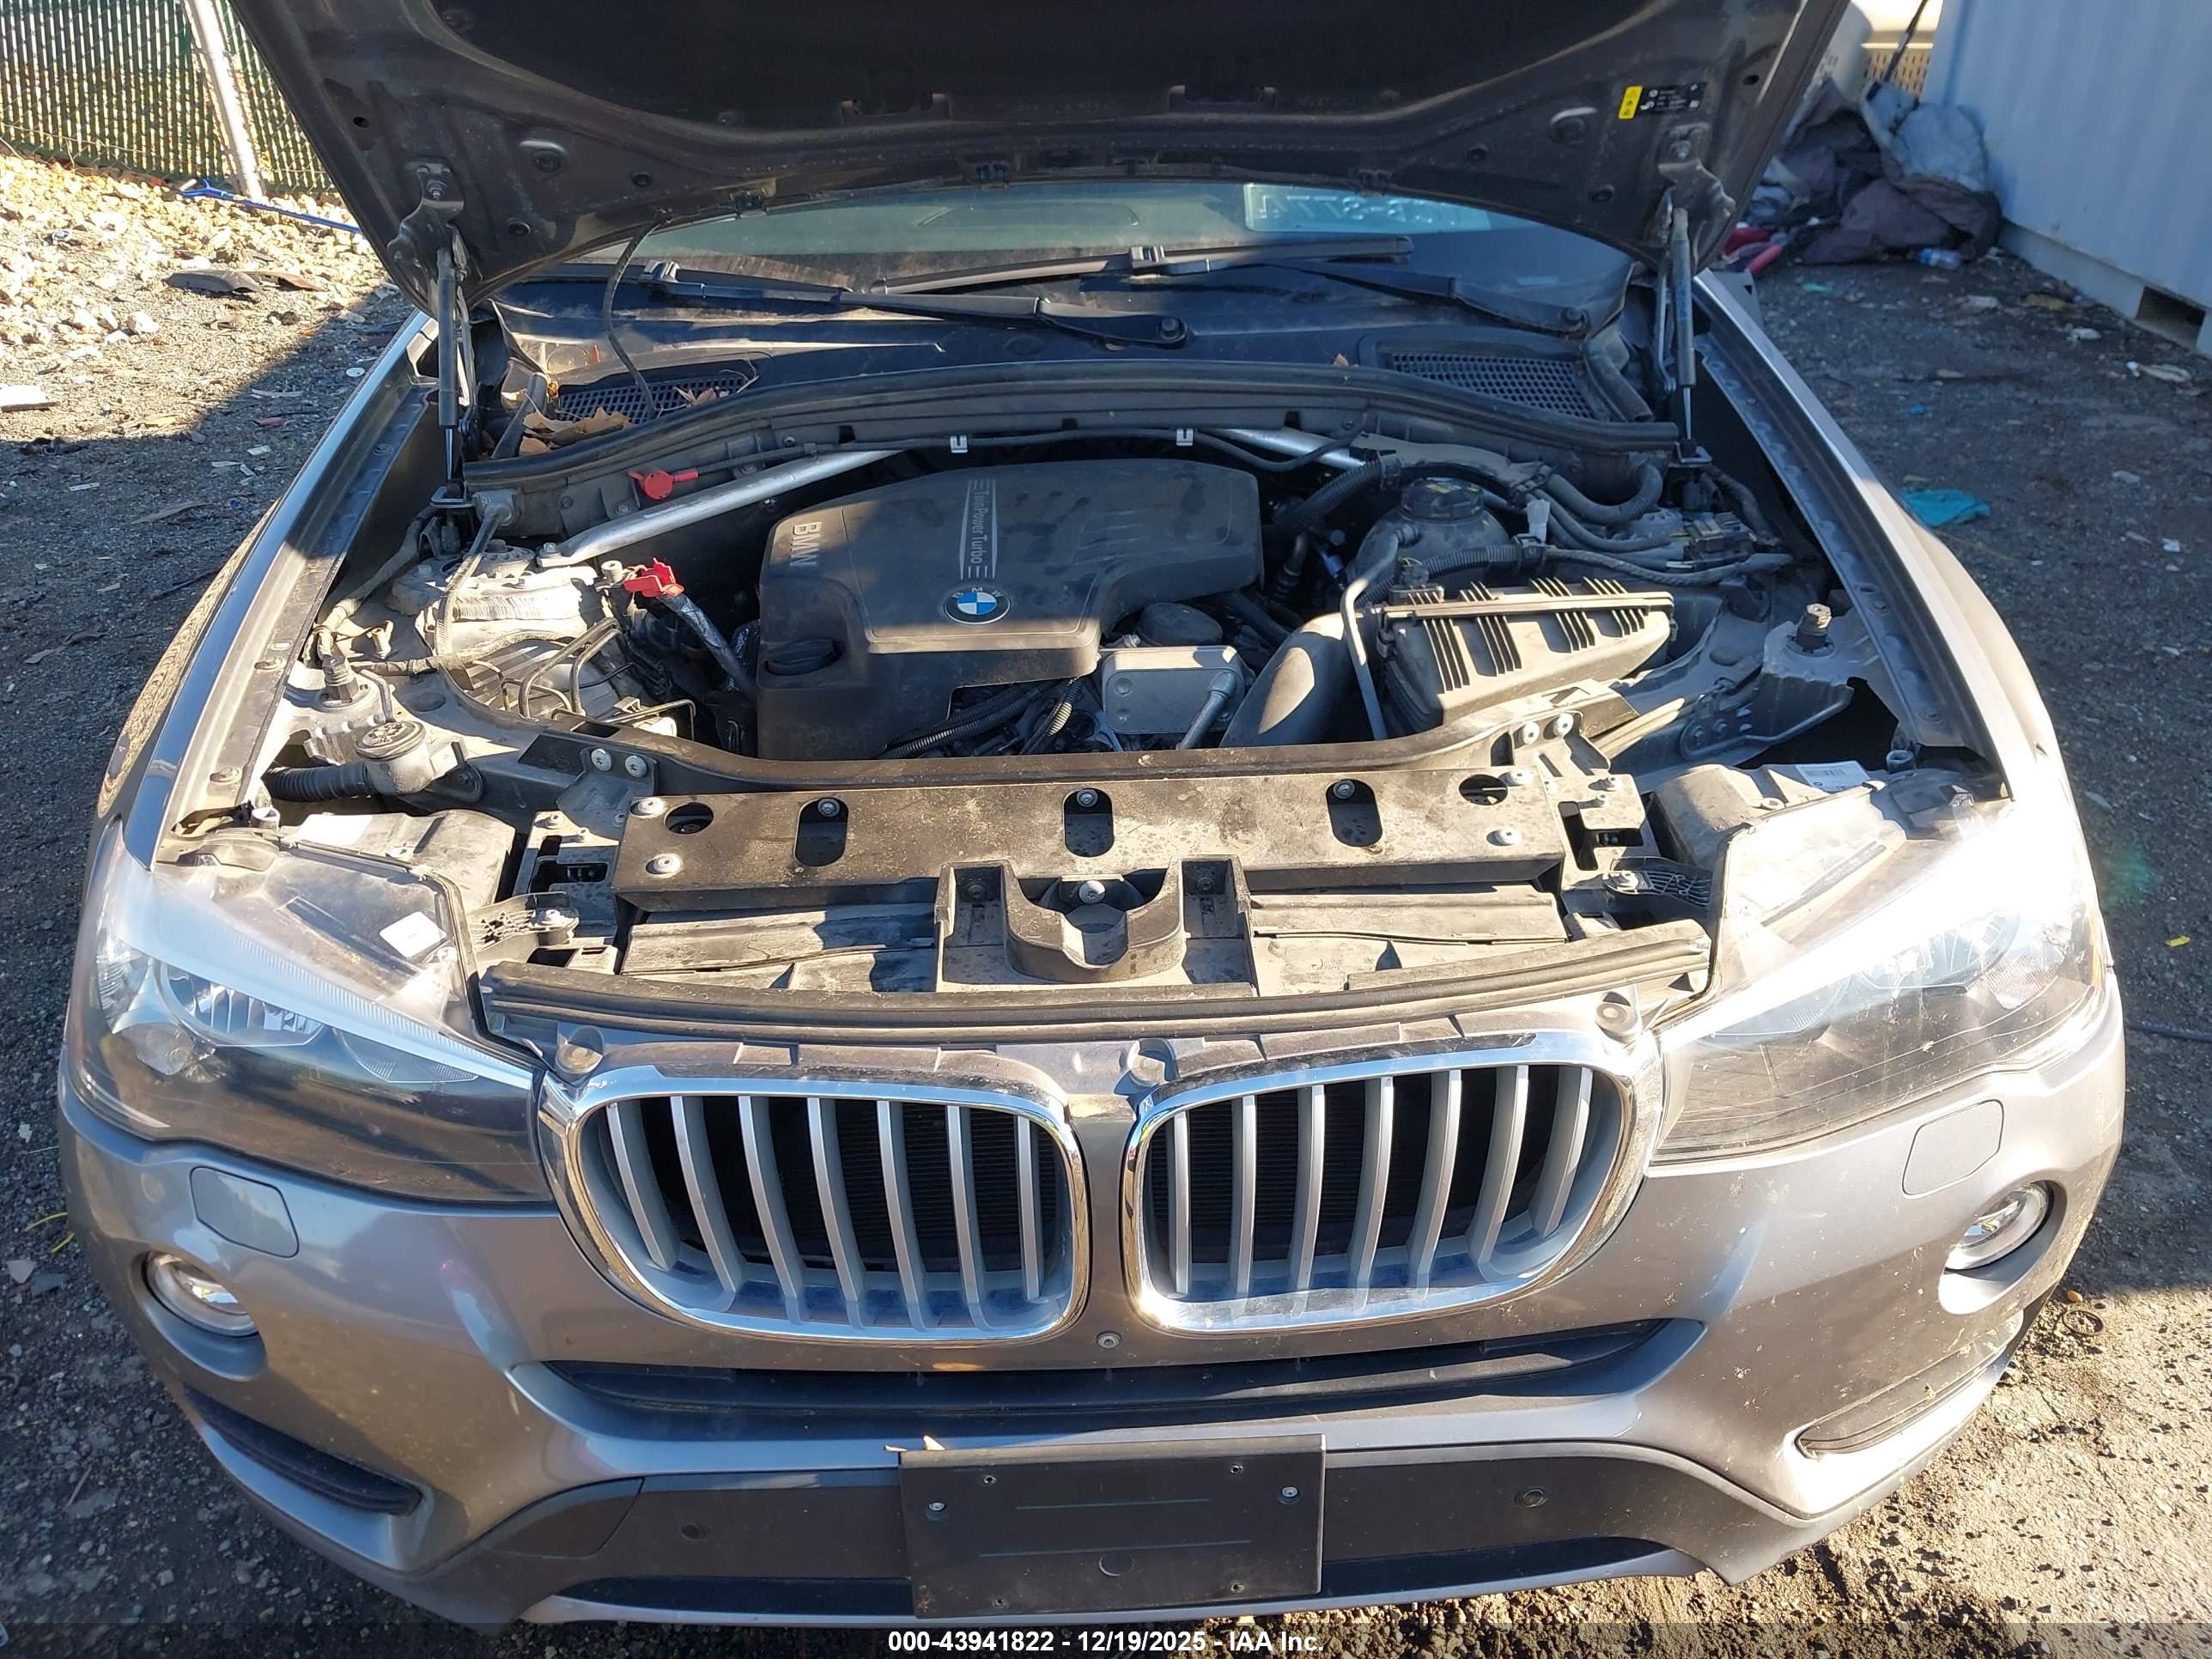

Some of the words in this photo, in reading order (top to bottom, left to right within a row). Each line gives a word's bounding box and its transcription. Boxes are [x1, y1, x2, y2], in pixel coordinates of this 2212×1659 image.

[970, 490, 989, 533] TwinPower
[789, 521, 822, 567] BMW
[969, 535, 988, 564] Turbo
